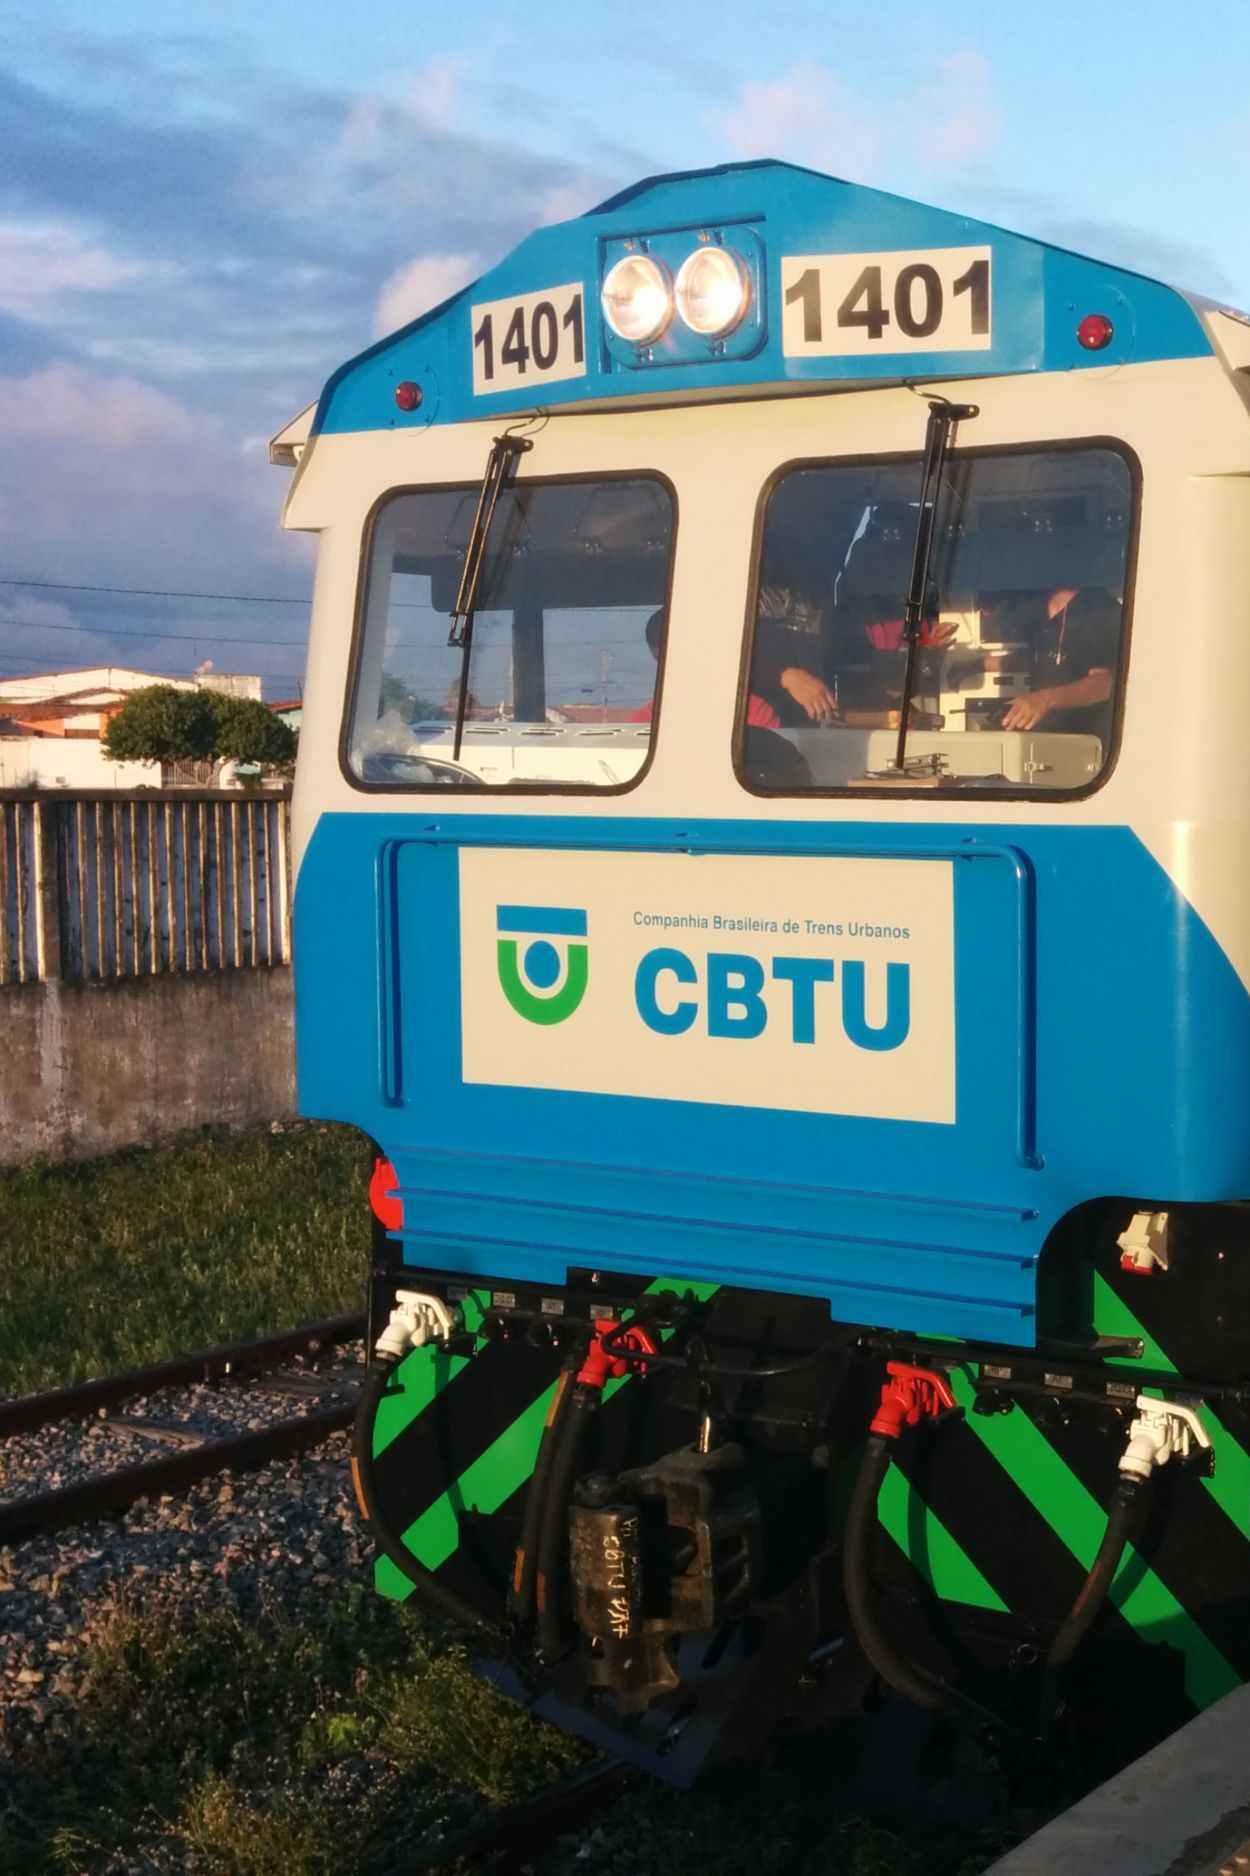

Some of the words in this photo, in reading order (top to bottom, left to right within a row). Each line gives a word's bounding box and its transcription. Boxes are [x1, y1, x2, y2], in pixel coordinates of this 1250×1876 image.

[474, 293, 584, 381] 1401
[785, 260, 989, 343] 1401
[633, 911, 709, 929] Companhia
[713, 915, 778, 932] Brasileira
[783, 919, 800, 933] de
[804, 920, 843, 936] Trens
[848, 922, 910, 939] Urbanos
[635, 947, 910, 1051] CBTU
